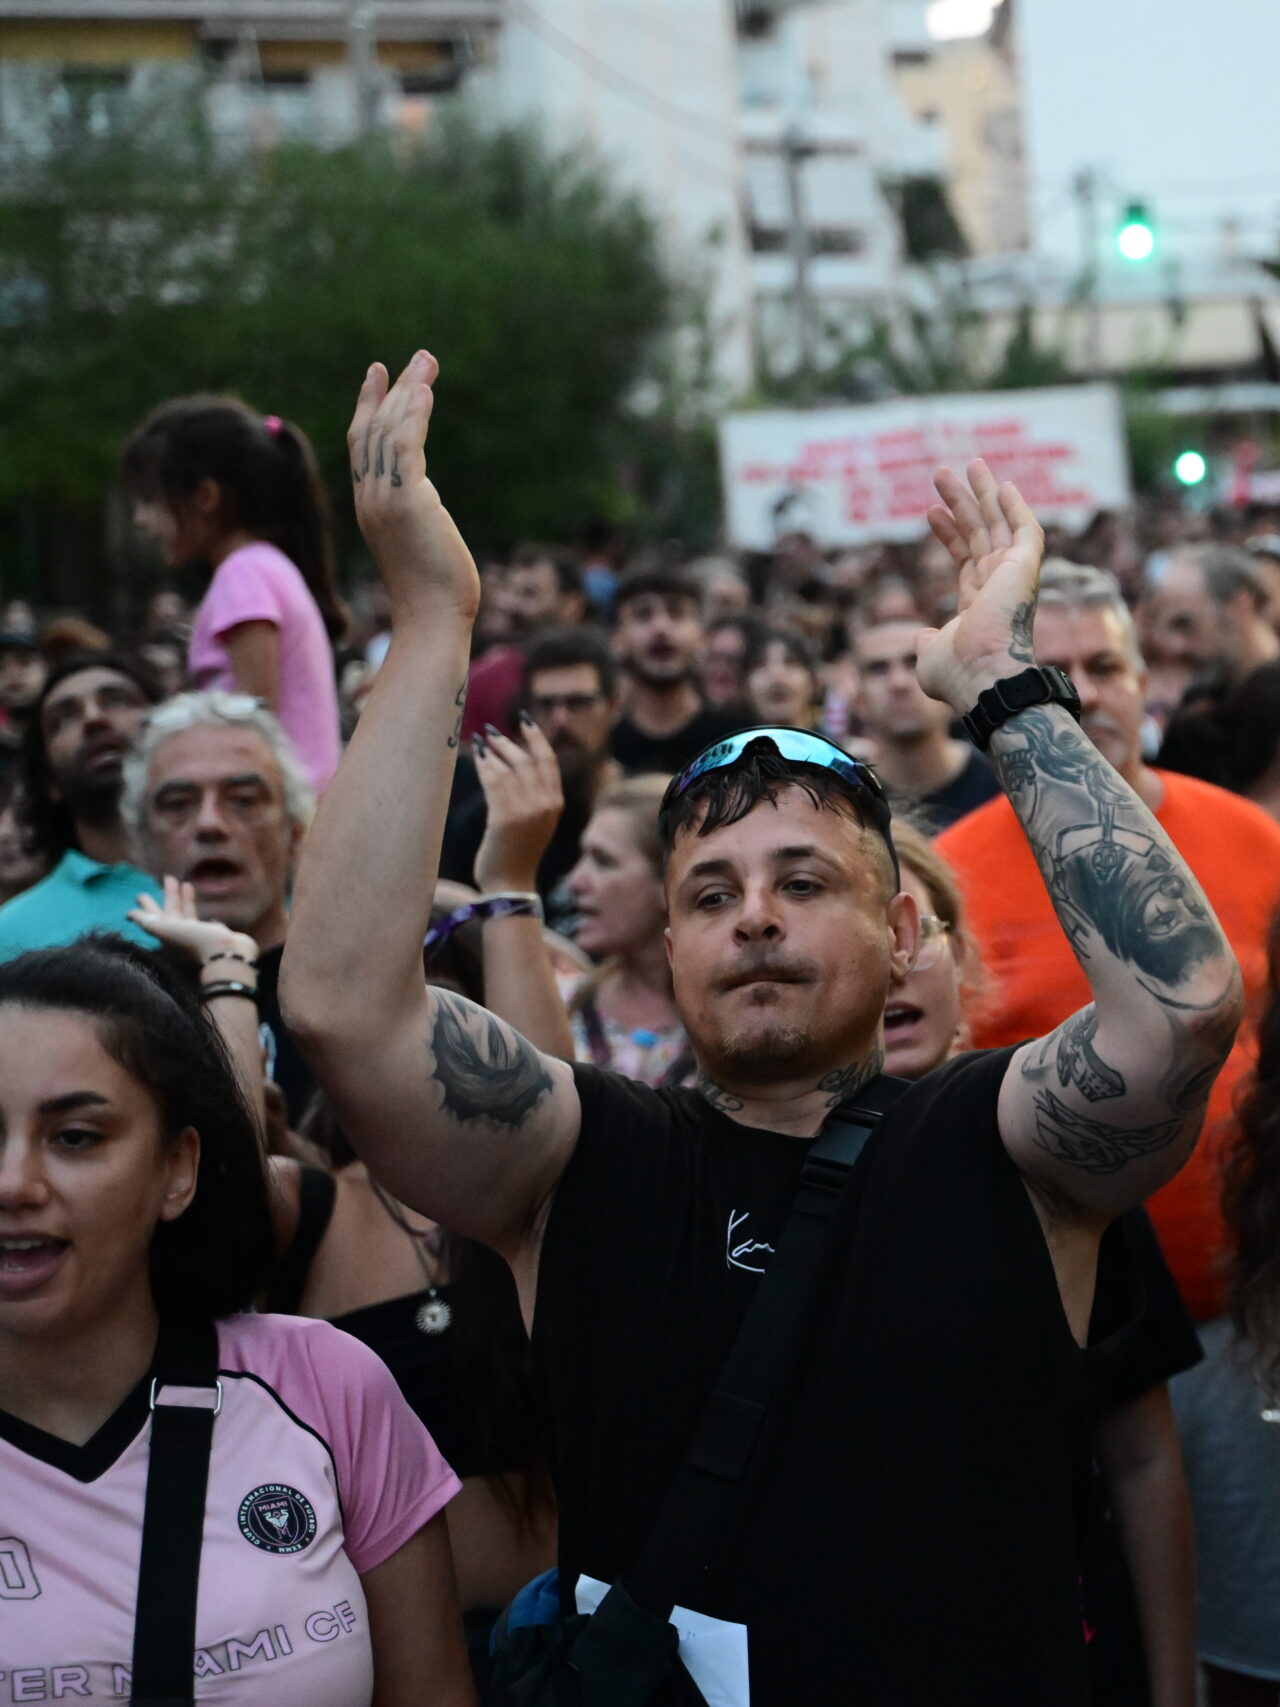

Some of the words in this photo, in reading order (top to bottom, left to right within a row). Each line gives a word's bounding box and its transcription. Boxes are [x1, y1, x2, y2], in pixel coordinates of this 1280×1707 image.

[240, 1486, 292, 1525] INTERNACIONAL
[258, 1500, 288, 1511] MIAMI
[295, 1493, 305, 1503] DE
[243, 1528, 261, 1545] CLUB
[0, 1665, 92, 1702] ER
[304, 1600, 356, 1643] CF
